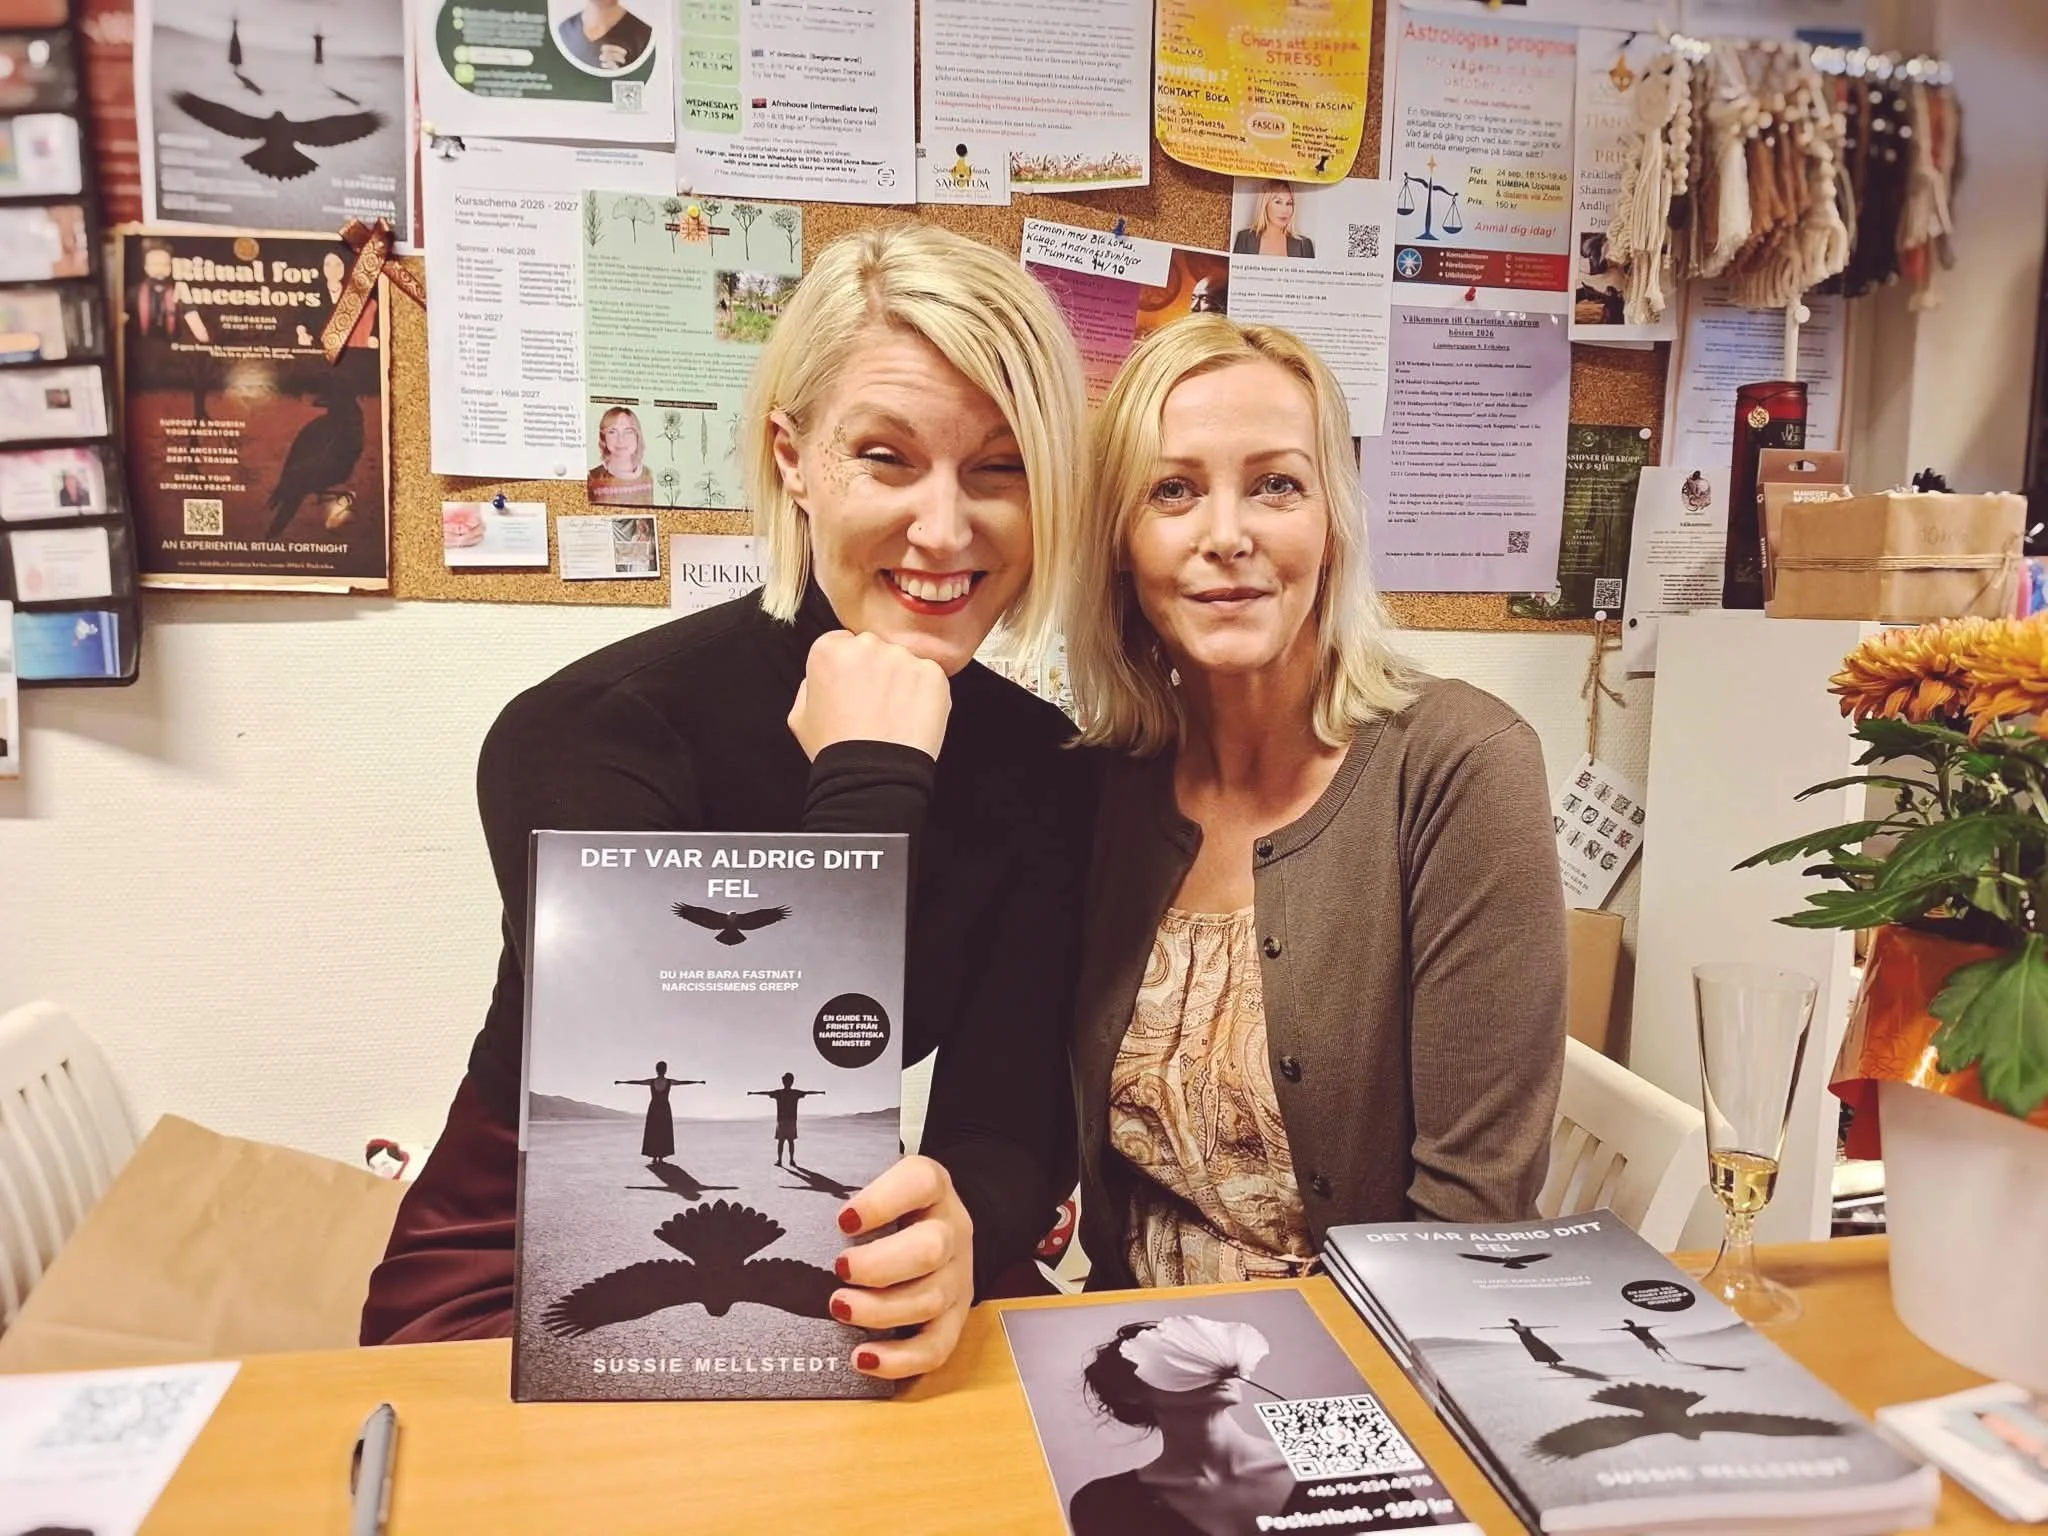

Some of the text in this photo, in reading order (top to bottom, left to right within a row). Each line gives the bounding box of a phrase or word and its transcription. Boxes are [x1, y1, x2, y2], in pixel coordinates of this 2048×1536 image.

[1404, 19, 1500, 50] Astrologisk
[1241, 31, 1282, 49] Chans
[1287, 37, 1306, 50] att
[1266, 49, 1322, 68] STRESS
[1157, 84, 1201, 99] KONTAKT
[685, 98, 739, 111] WEDNESDAYS
[1254, 95, 1274, 104] HELA
[771, 99, 878, 115] Afrohouse (intermediate level)
[1157, 103, 1177, 114] Sofie
[690, 109, 735, 121] AT PM
[843, 118, 863, 126] Dance
[864, 119, 877, 127] Hall
[1438, 120, 1453, 129] och
[1406, 128, 1422, 138] Vad
[1432, 131, 1443, 140] på
[1444, 133, 1464, 144] gång
[1465, 135, 1481, 143] och
[1482, 136, 1496, 144] vad
[1532, 141, 1550, 149] göra
[1405, 140, 1416, 148] att
[1417, 141, 1446, 151] bemöta
[1448, 144, 1489, 155] energierna
[1490, 148, 1500, 157] på
[767, 153, 797, 162] WhatsApp
[1496, 168, 1506, 177] 24
[935, 178, 990, 191] SANCTUM
[1496, 180, 1530, 190] KUMBHA
[1531, 182, 1561, 192] Uppsala
[1541, 193, 1564, 202] Zoom
[454, 195, 518, 209] Kursschema
[553, 201, 579, 212] 2027
[1495, 200, 1509, 209] 150
[1510, 201, 1518, 210] kr
[1474, 221, 1557, 238] Anmäl dig idag!
[1068, 230, 1089, 241] med
[171, 256, 319, 284] Ritual for
[1091, 258, 1126, 276] 14/10
[172, 281, 321, 307] Ancestors
[1402, 314, 1506, 327] Välkommen till Charlottas
[1448, 329, 1495, 338] hösten 2026
[160, 419, 198, 428] SUPPORT
[165, 428, 241, 437] YOUR ANCESTORS
[190, 447, 239, 455] ANCESTRAL
[202, 456, 240, 464] TRAUMA
[1601, 453, 1616, 463] FÖR
[208, 474, 232, 482] YOUR
[159, 482, 247, 492] SPIRITUAL PRACTICE
[161, 540, 349, 554] AN EXPERIENTIAL RITUAL FORTNIGHT
[580, 848, 885, 870] DET VAR ALDRIG DITT
[707, 879, 759, 898] FEL
[659, 970, 802, 980] DU HAR BARA FASTNAT I
[661, 982, 800, 992] NARCISSISMENS GREPP
[835, 1014, 861, 1022] GUIDE
[855, 1022, 878, 1030] FRÅN
[818, 1031, 885, 1039] NARCISSISTISKA
[831, 1039, 872, 1047] MÖNSTER
[1366, 1221, 1602, 1244] DET VAR ALDRIG DITT
[1474, 1242, 1522, 1253] FEL
[592, 1356, 840, 1374] SUSSIE MELLSTEDT
[1596, 1456, 1851, 1487] SUSSIE MELLSTEDT
[1255, 1505, 1374, 1532] Pocketbok
